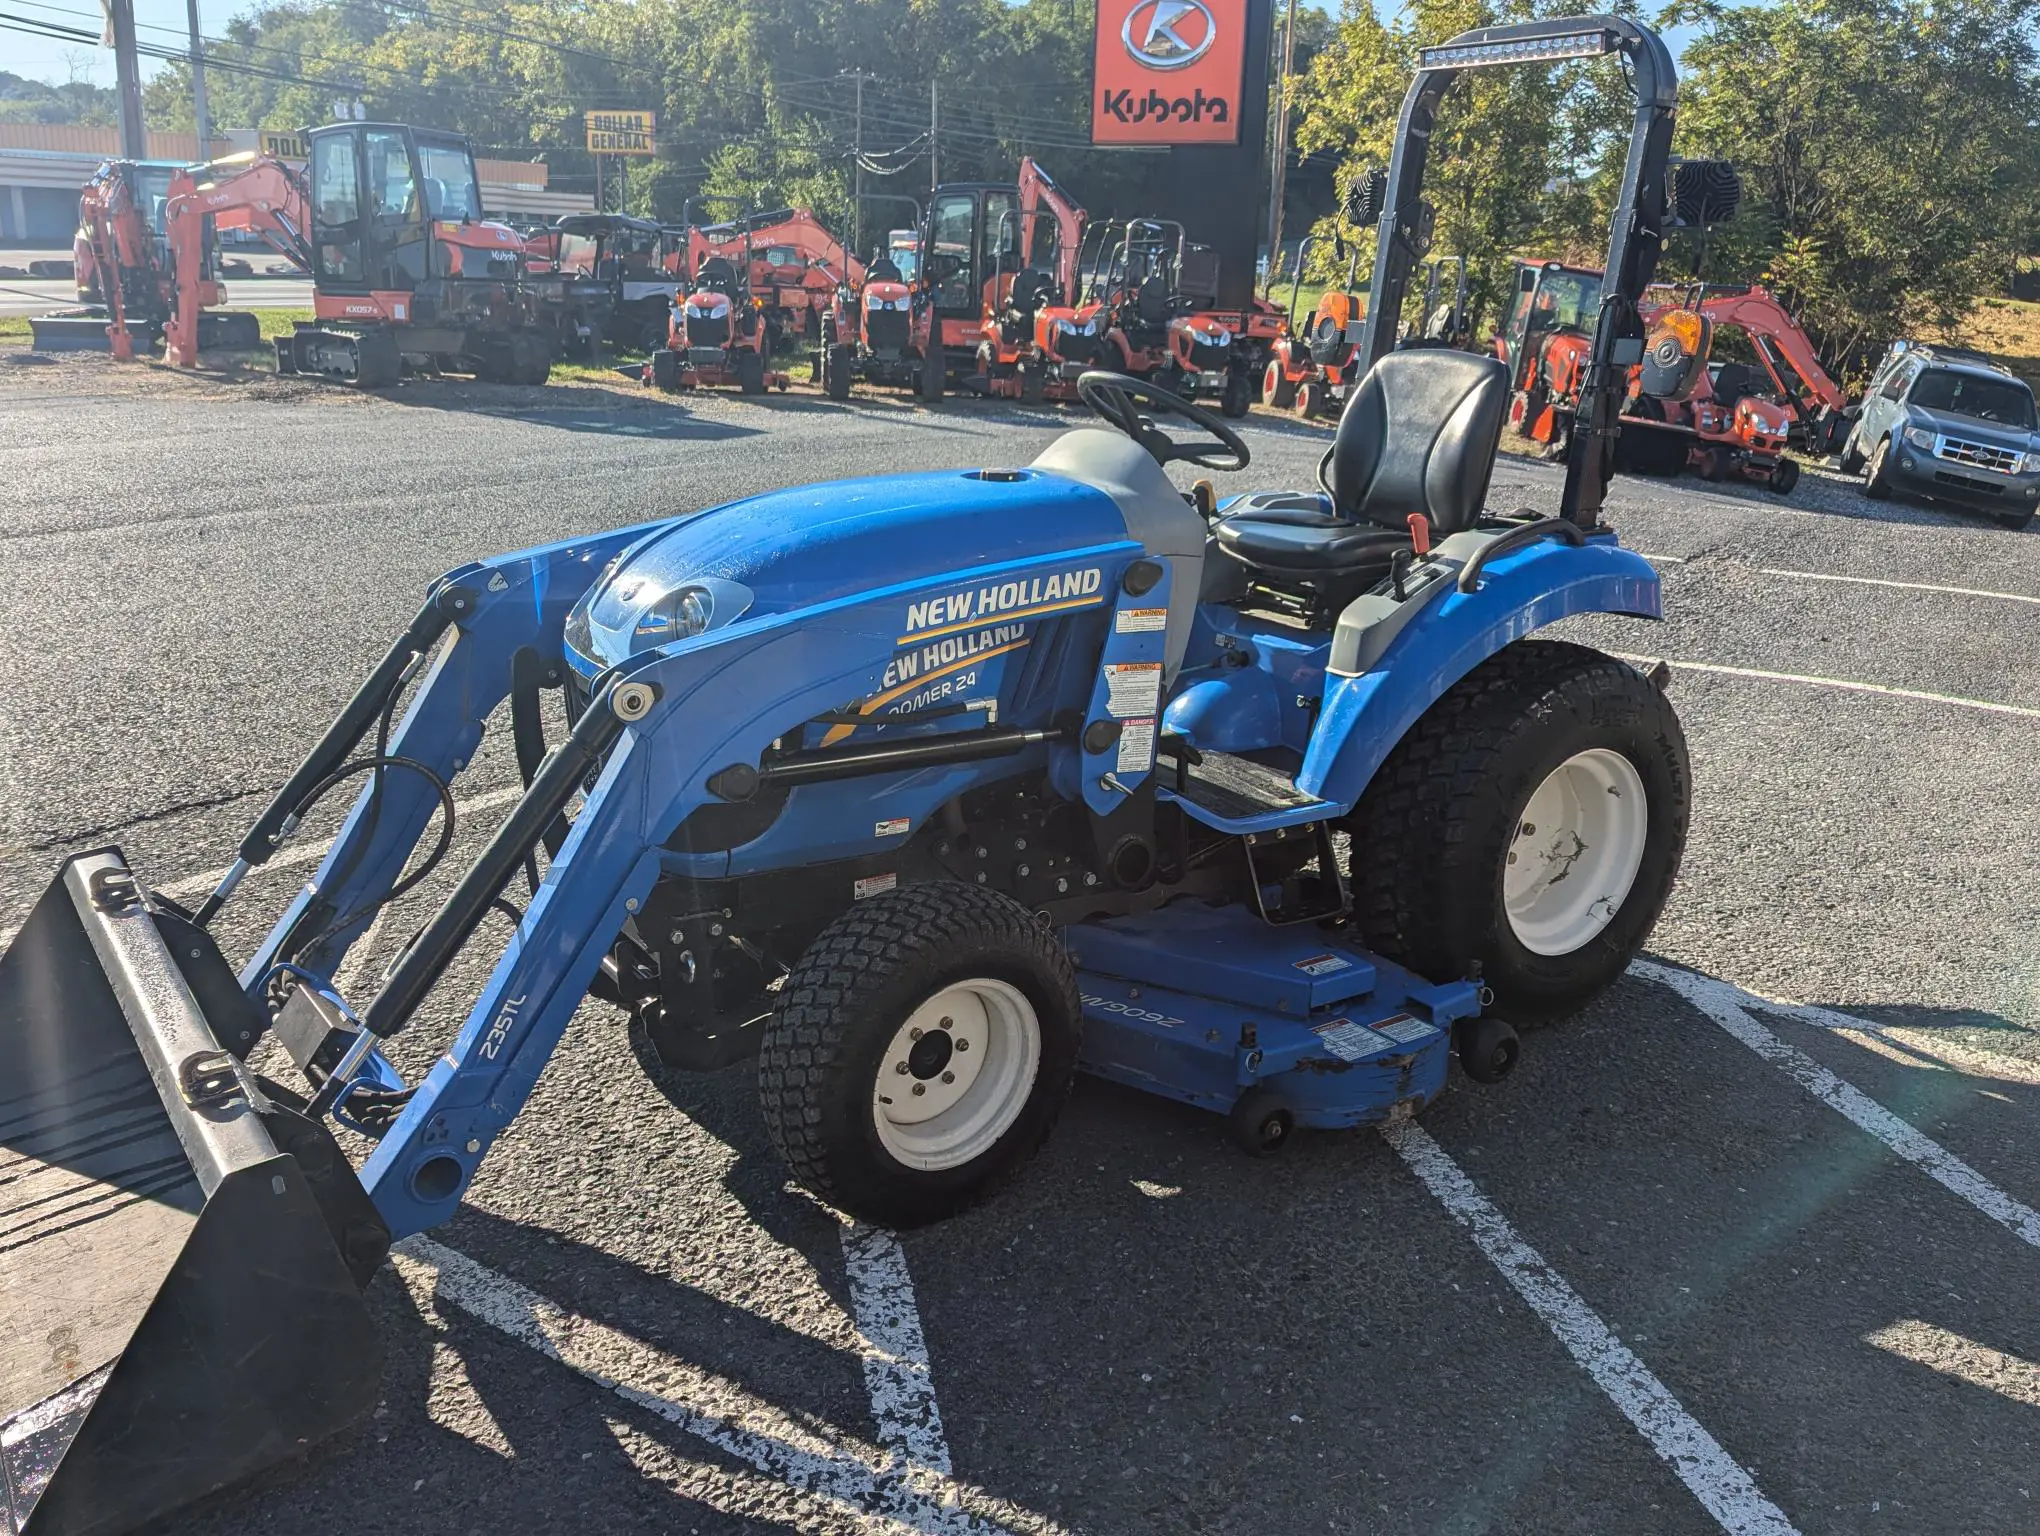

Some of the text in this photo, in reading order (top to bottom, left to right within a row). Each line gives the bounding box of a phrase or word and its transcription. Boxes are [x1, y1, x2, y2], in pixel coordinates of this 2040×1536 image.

[1103, 88, 1228, 122] Kubota
[594, 115, 643, 131] DOLLAR
[592, 133, 648, 149] GENERAL
[906, 568, 1100, 631] NEW HOLLAND
[876, 623, 1024, 692] EW HOLLAND
[955, 671, 976, 692] 24
[478, 995, 526, 1060] 235TL
